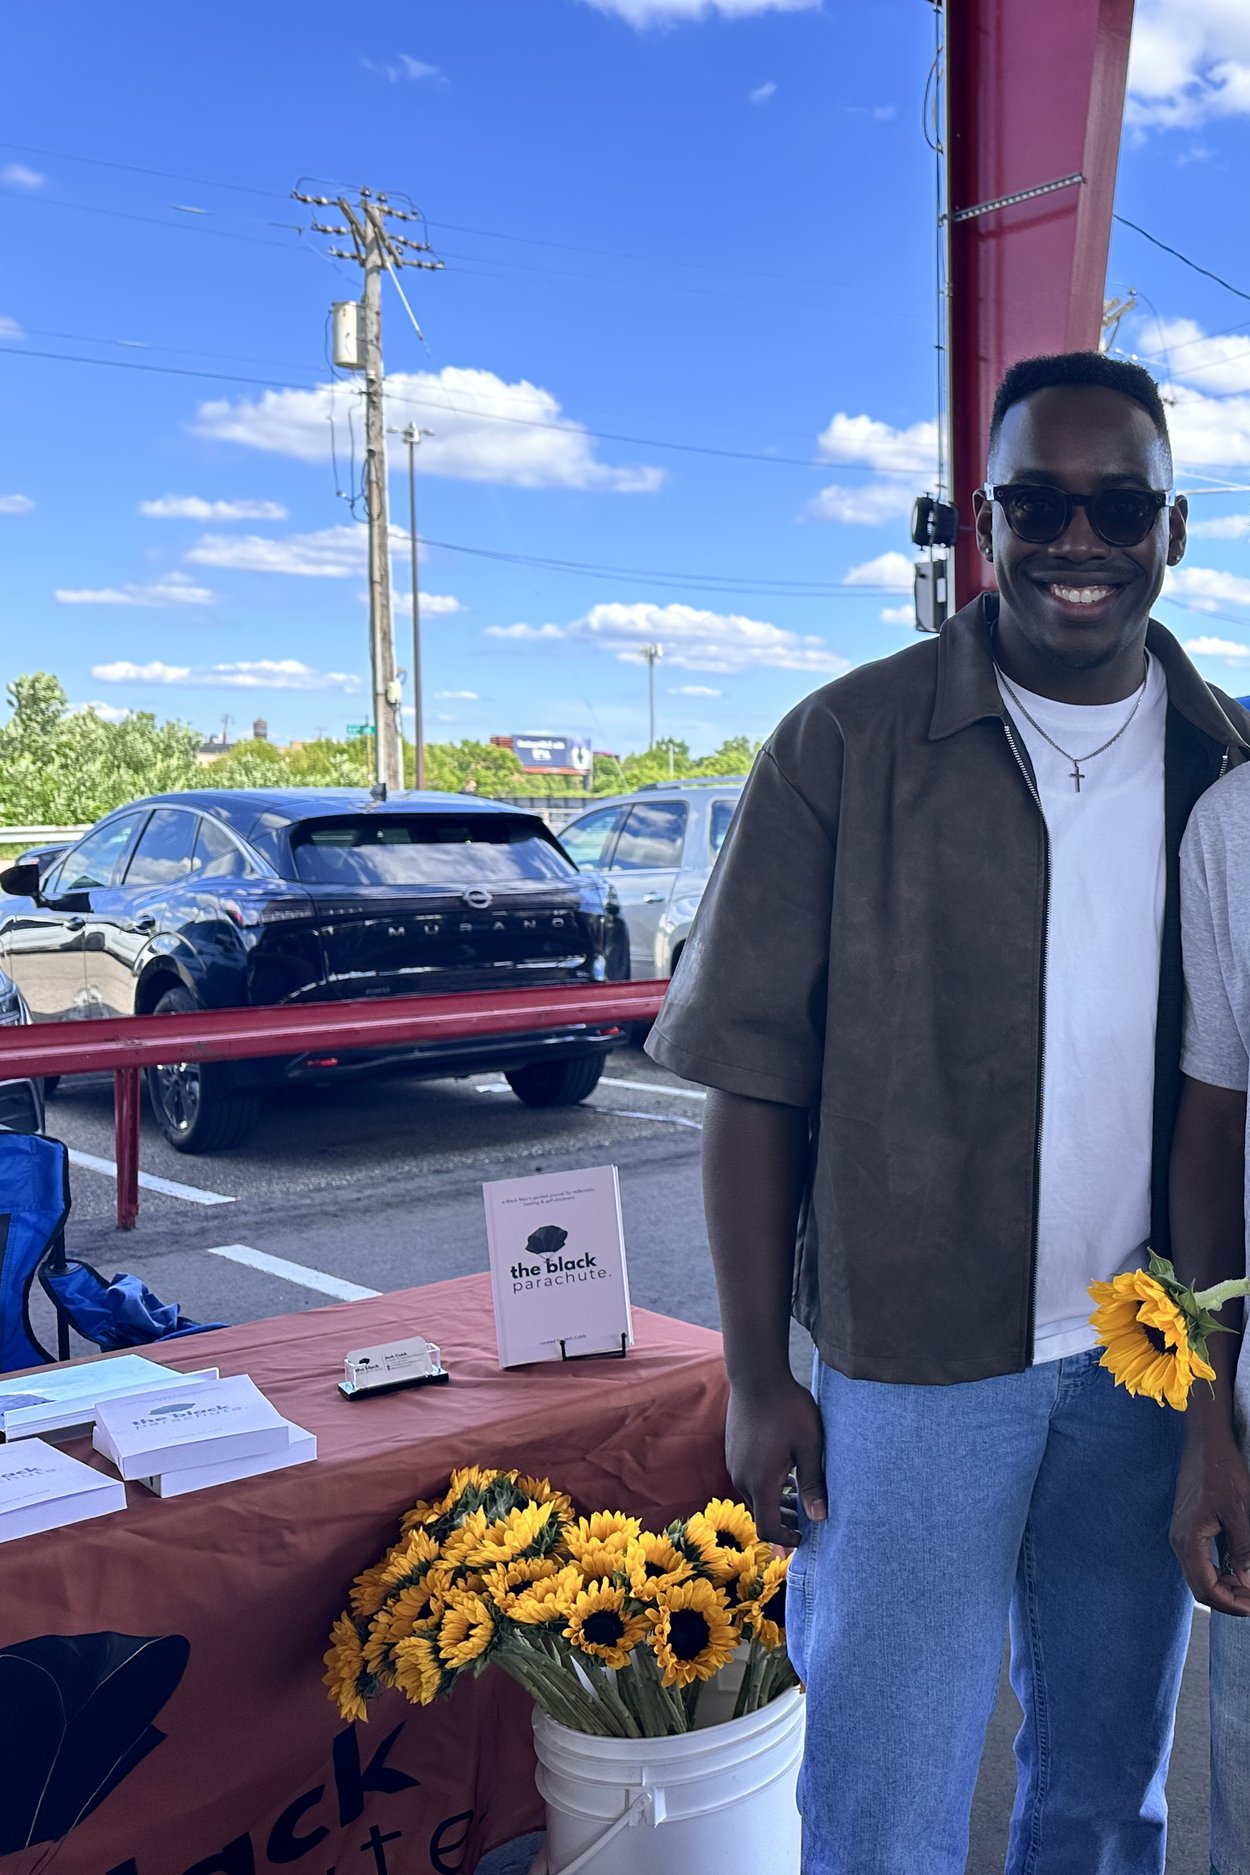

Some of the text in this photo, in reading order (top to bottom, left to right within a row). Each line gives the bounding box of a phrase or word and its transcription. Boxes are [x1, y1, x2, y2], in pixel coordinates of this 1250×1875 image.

[388, 917, 565, 937] MURANO
[510, 1252, 597, 1279] the black
[512, 1266, 612, 1295] parachute.
[172, 1403, 230, 1419] black
[0, 1466, 39, 1479] ack
